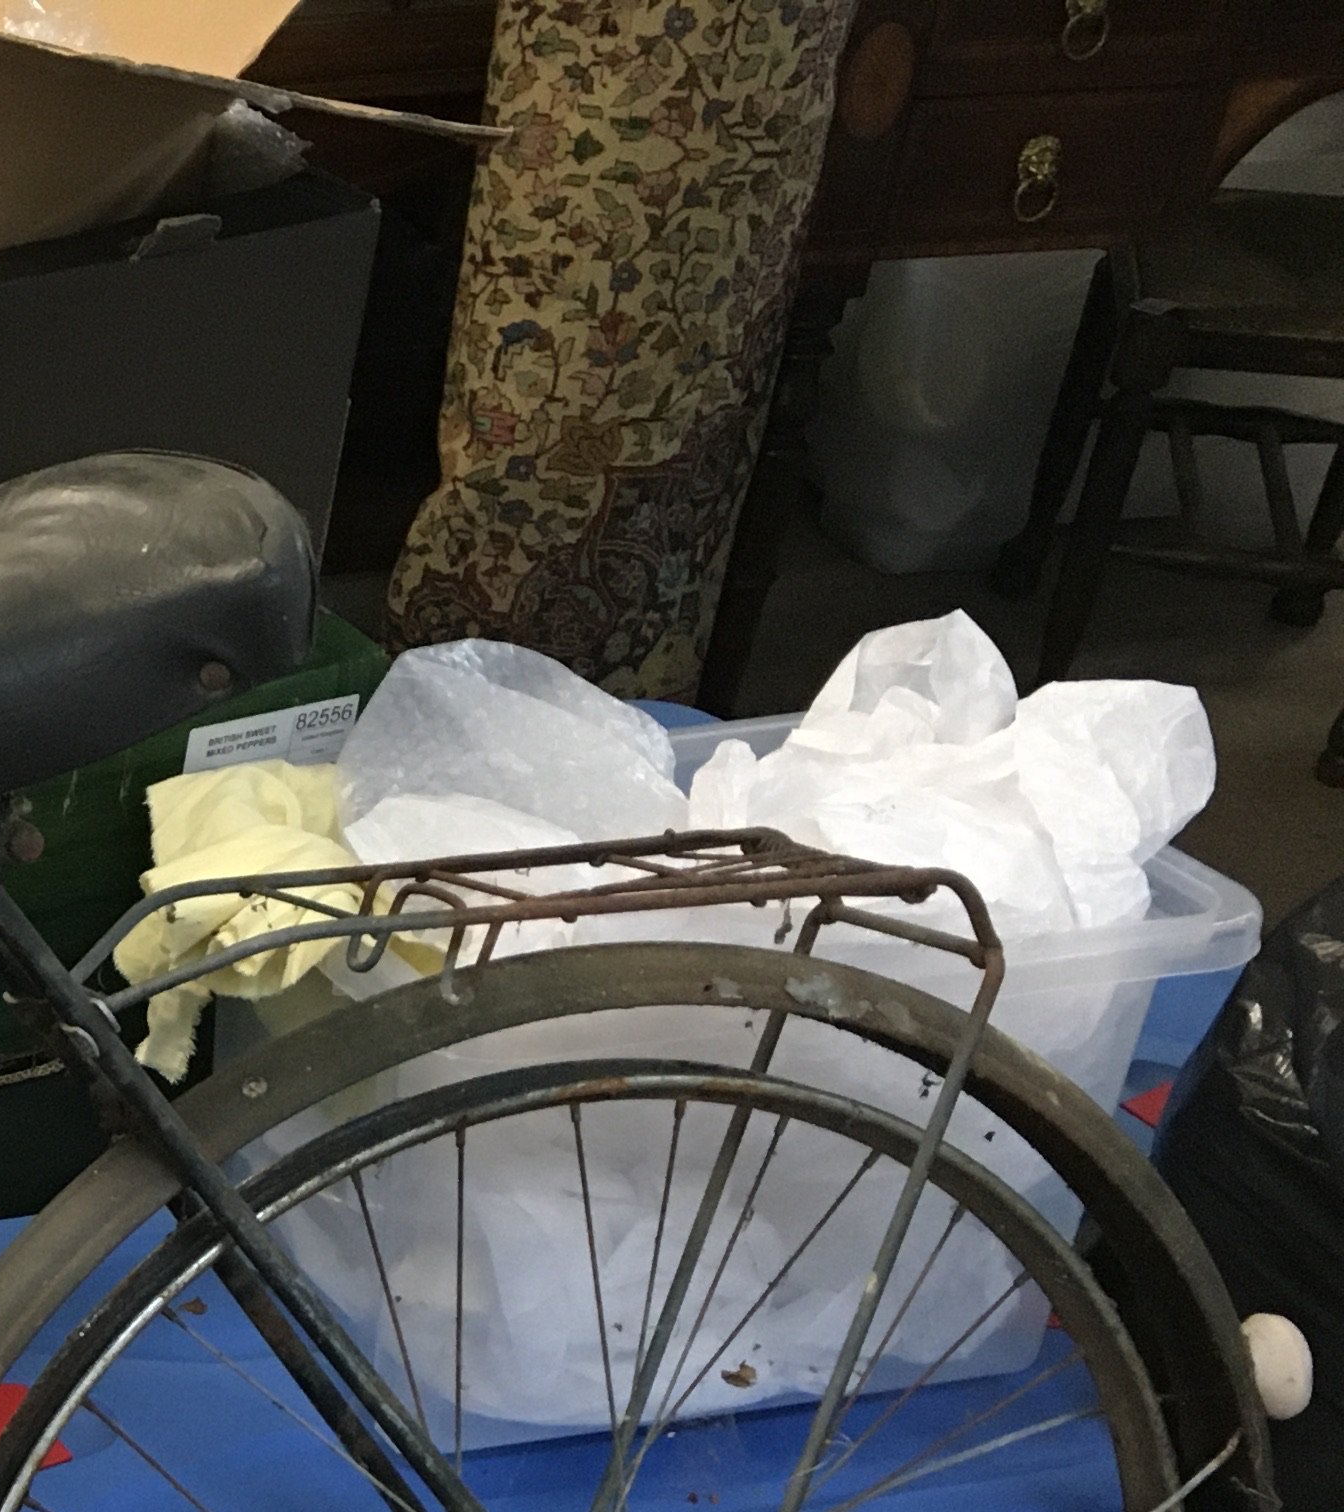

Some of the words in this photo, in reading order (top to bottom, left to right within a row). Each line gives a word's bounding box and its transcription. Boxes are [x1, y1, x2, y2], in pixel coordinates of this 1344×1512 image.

[296, 703, 354, 730] 82556
[208, 733, 243, 747] BRITISH
[245, 725, 277, 739] SWEET
[237, 735, 277, 750] PEPPERS
